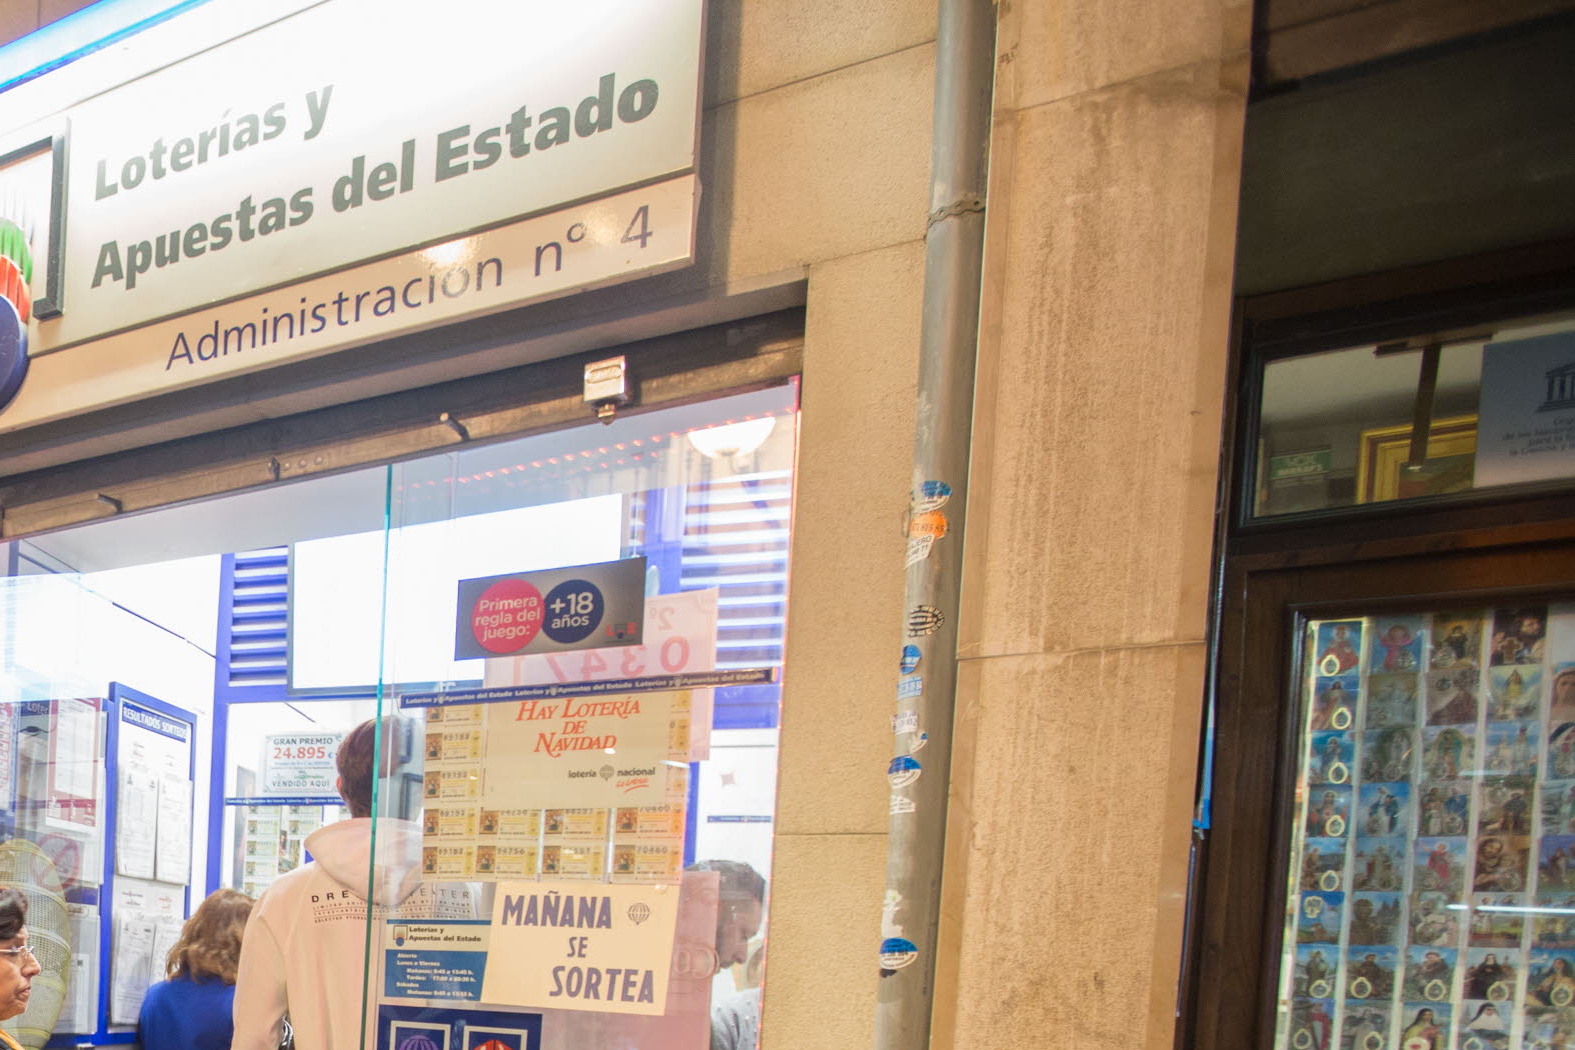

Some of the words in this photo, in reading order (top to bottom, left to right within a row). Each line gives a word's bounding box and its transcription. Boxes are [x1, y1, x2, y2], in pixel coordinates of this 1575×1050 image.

[94, 105, 287, 202] Loterías
[303, 84, 335, 140] y
[90, 191, 318, 289] Apuestas
[330, 139, 415, 213] del
[434, 72, 659, 180] Estado
[620, 203, 655, 250] 4
[479, 596, 538, 612] Primera
[550, 591, 594, 615] +18
[475, 611, 513, 628] regla
[517, 607, 541, 622] del
[551, 613, 590, 629] años
[483, 623, 530, 641] juego:
[516, 699, 559, 722] HAY
[561, 696, 641, 720] LOTERÍA
[561, 720, 587, 735] DE
[273, 737, 297, 745] GRAN
[299, 737, 333, 745] PREMIO
[534, 732, 617, 758] NAVIDAD
[273, 746, 326, 759] 24.895
[617, 767, 656, 778] nacional
[272, 780, 308, 788] VENDIDO
[502, 890, 612, 929] MAÑANA
[567, 936, 589, 958] SE
[549, 965, 654, 1004] SORTEA
